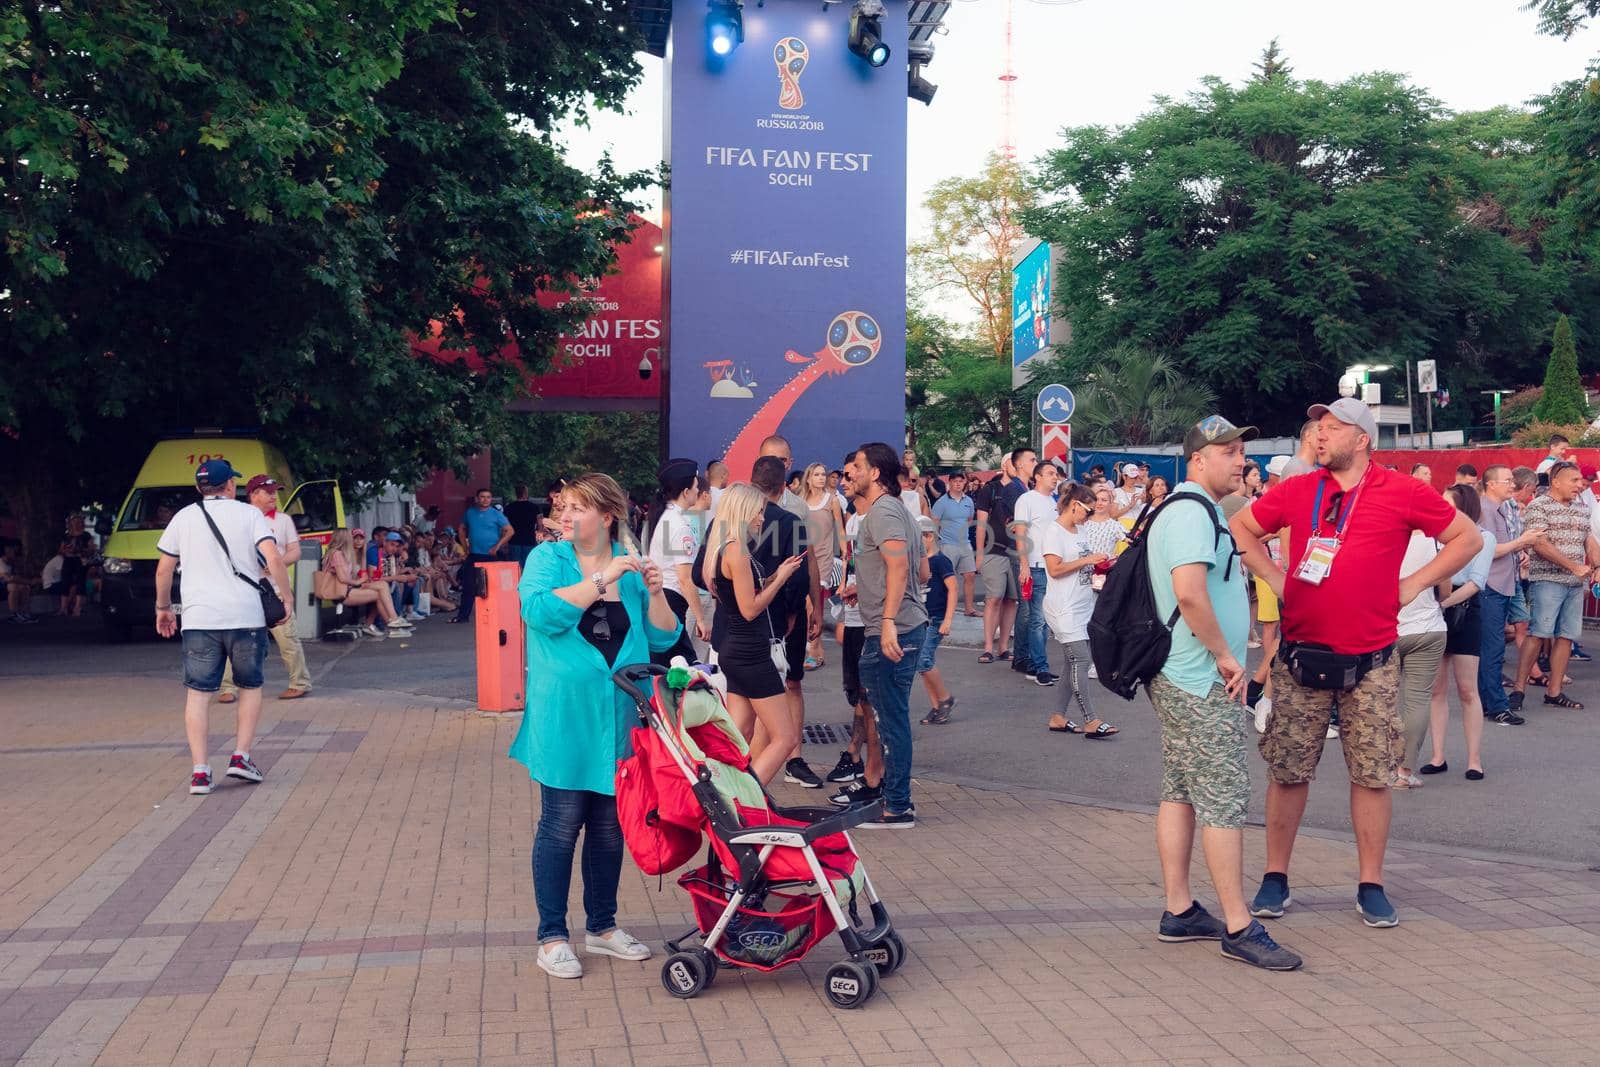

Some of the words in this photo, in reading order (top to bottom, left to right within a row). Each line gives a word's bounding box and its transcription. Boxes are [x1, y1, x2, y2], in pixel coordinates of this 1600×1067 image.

[756, 119, 798, 129] RUSSIA
[799, 120, 824, 131] 2018
[706, 147, 757, 167] FIFA
[763, 149, 810, 169] FAN
[816, 152, 872, 171] FEST
[768, 173, 812, 186] SOCHI
[730, 250, 850, 268] #FIFAFanFest
[615, 319, 662, 339] FES
[565, 344, 611, 357] SOCHI
[744, 935, 779, 947] SECA
[675, 965, 691, 987] SECA
[832, 981, 856, 991] SECA
